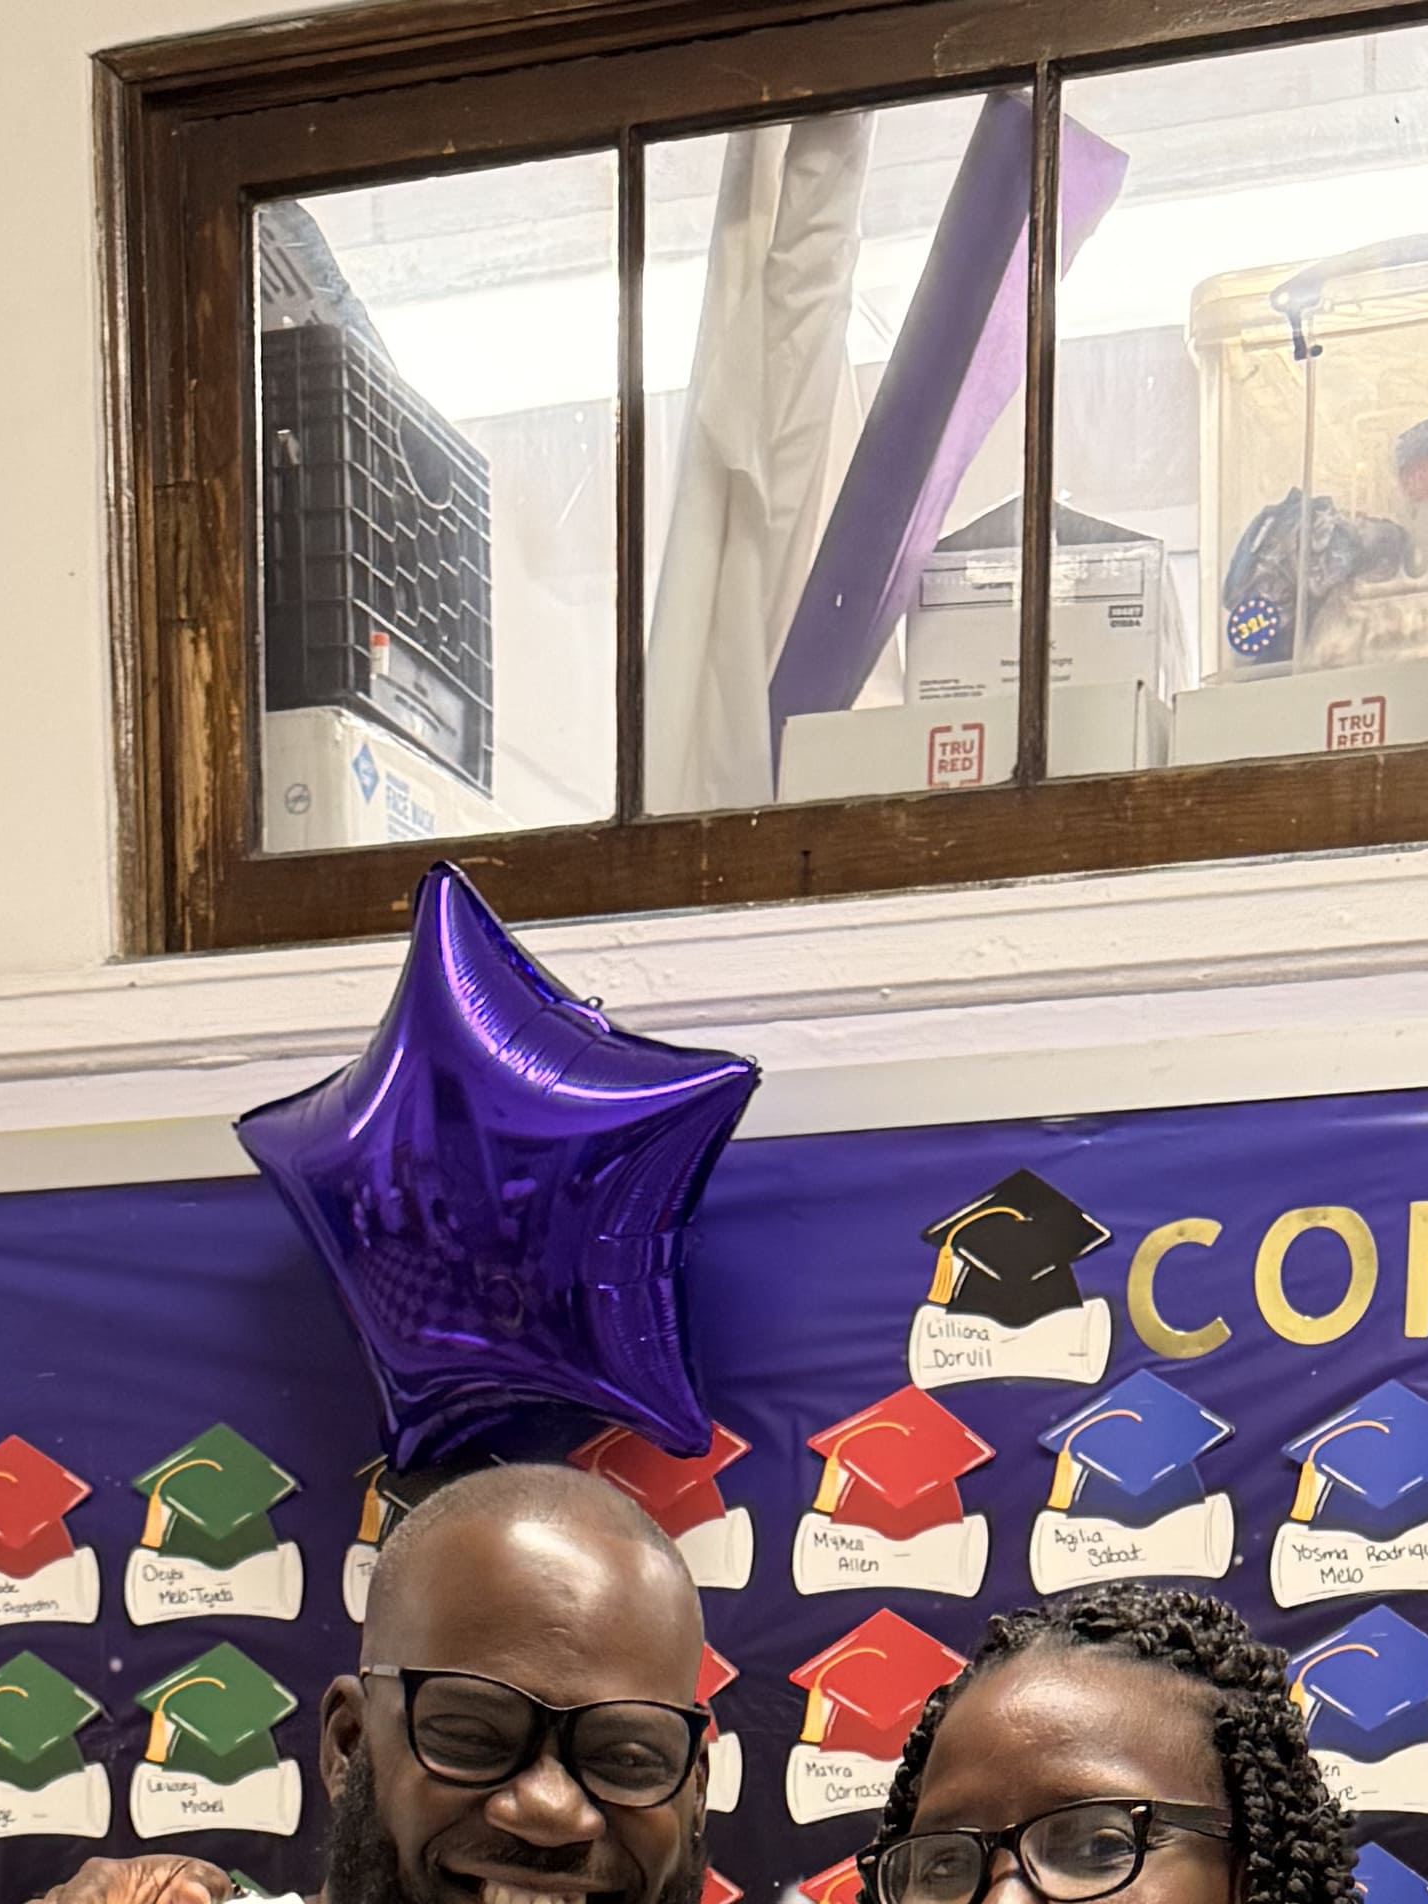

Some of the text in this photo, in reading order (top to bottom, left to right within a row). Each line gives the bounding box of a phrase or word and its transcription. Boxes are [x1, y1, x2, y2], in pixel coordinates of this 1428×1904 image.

[1338, 713, 1376, 732] TRU
[939, 740, 975, 757] TRU
[937, 757, 973, 774] RED
[838, 1556, 879, 1573] Allen
